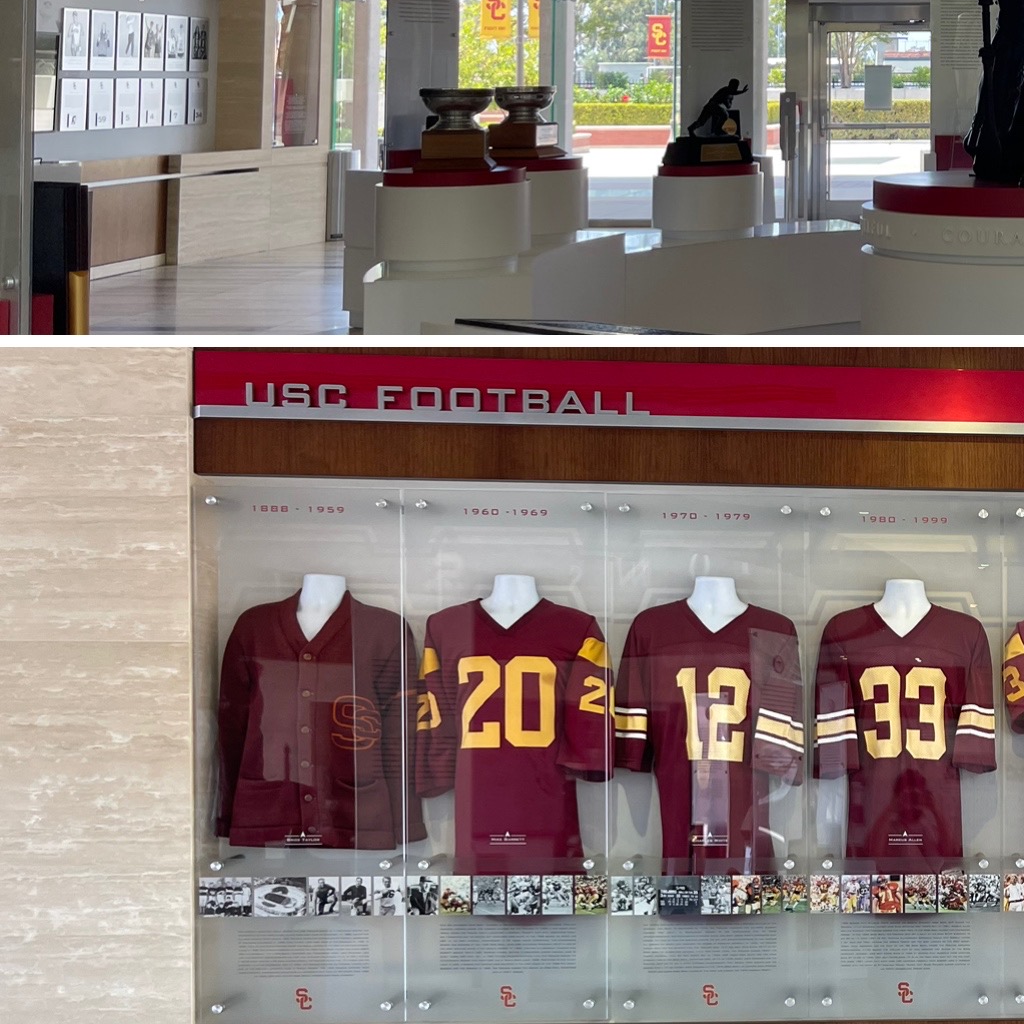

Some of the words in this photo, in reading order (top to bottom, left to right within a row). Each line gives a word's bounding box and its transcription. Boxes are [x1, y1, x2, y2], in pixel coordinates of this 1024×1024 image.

[652, 22, 667, 46] SC
[245, 381, 348, 410] USC
[377, 385, 651, 417] FOOTBALL
[252, 504, 289, 513] 1888
[308, 505, 345, 514] 1959
[463, 508, 499, 517] 1960
[661, 512, 699, 521] 1970
[715, 513, 751, 521] 1979
[861, 515, 897, 524] 1980
[913, 516, 949, 525] 1999
[457, 655, 557, 749] 20
[859, 665, 947, 760] 33
[675, 667, 751, 762] 12
[295, 987, 313, 1010] SC
[500, 985, 517, 1008] SC
[702, 984, 719, 1006] SC
[897, 981, 914, 1004] SC
